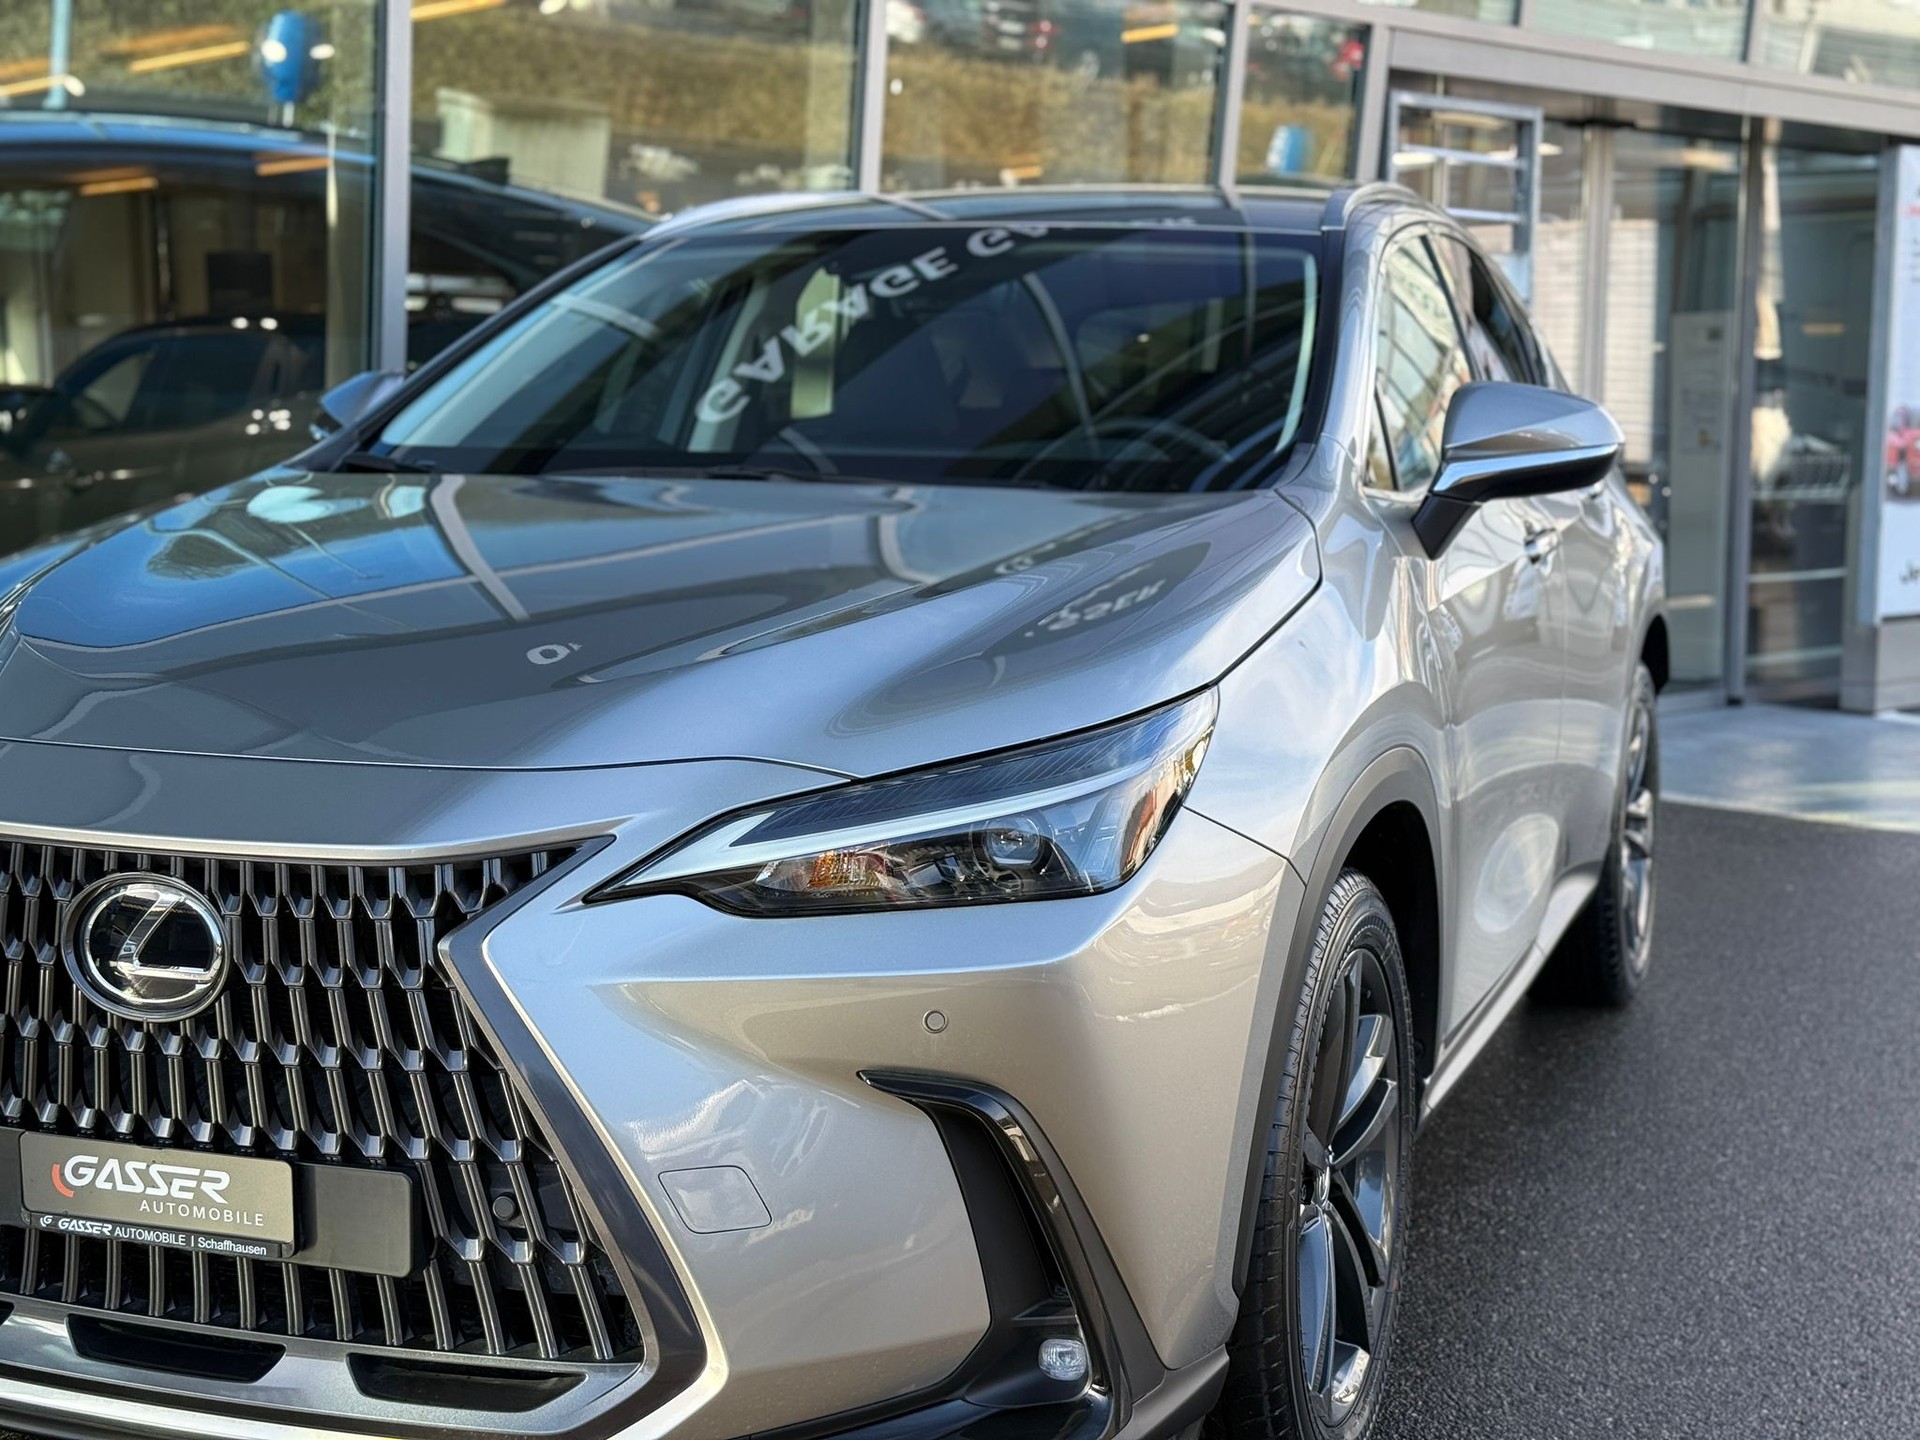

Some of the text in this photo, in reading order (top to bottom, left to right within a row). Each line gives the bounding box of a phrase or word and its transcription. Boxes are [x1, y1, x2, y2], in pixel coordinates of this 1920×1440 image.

[63, 1155, 231, 1204] GASSER
[140, 1199, 265, 1227] AUTOMOBILE
[58, 1218, 113, 1235] GASSER
[114, 1227, 186, 1246] AUTOMOBILE
[198, 1237, 267, 1256] Schaffhausen
